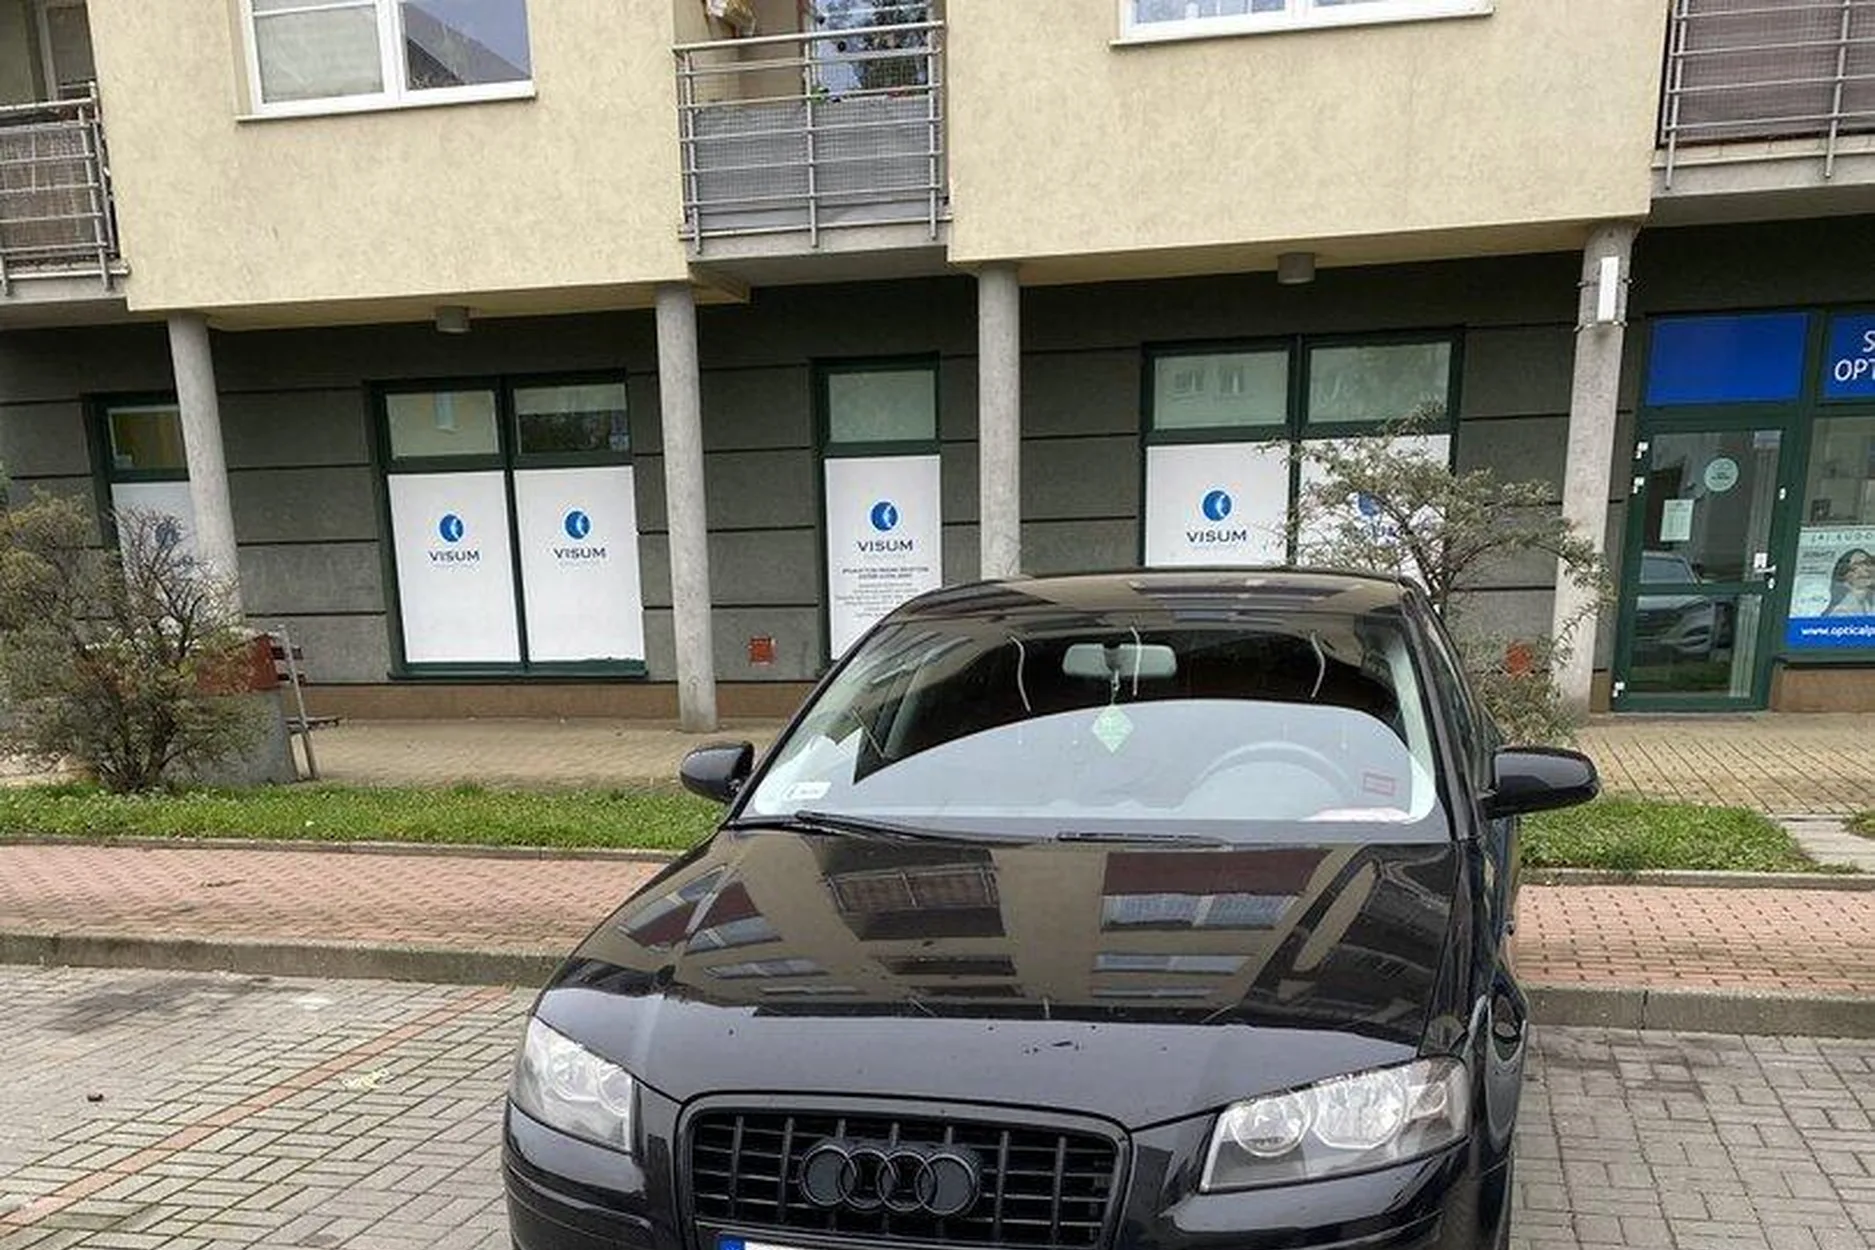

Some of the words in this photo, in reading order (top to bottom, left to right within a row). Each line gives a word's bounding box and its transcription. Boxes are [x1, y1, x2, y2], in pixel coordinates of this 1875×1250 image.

[1186, 529, 1247, 543] VISUM
[857, 539, 914, 552] VISUM
[428, 550, 480, 562] VISUM
[553, 547, 606, 560] VISUM
